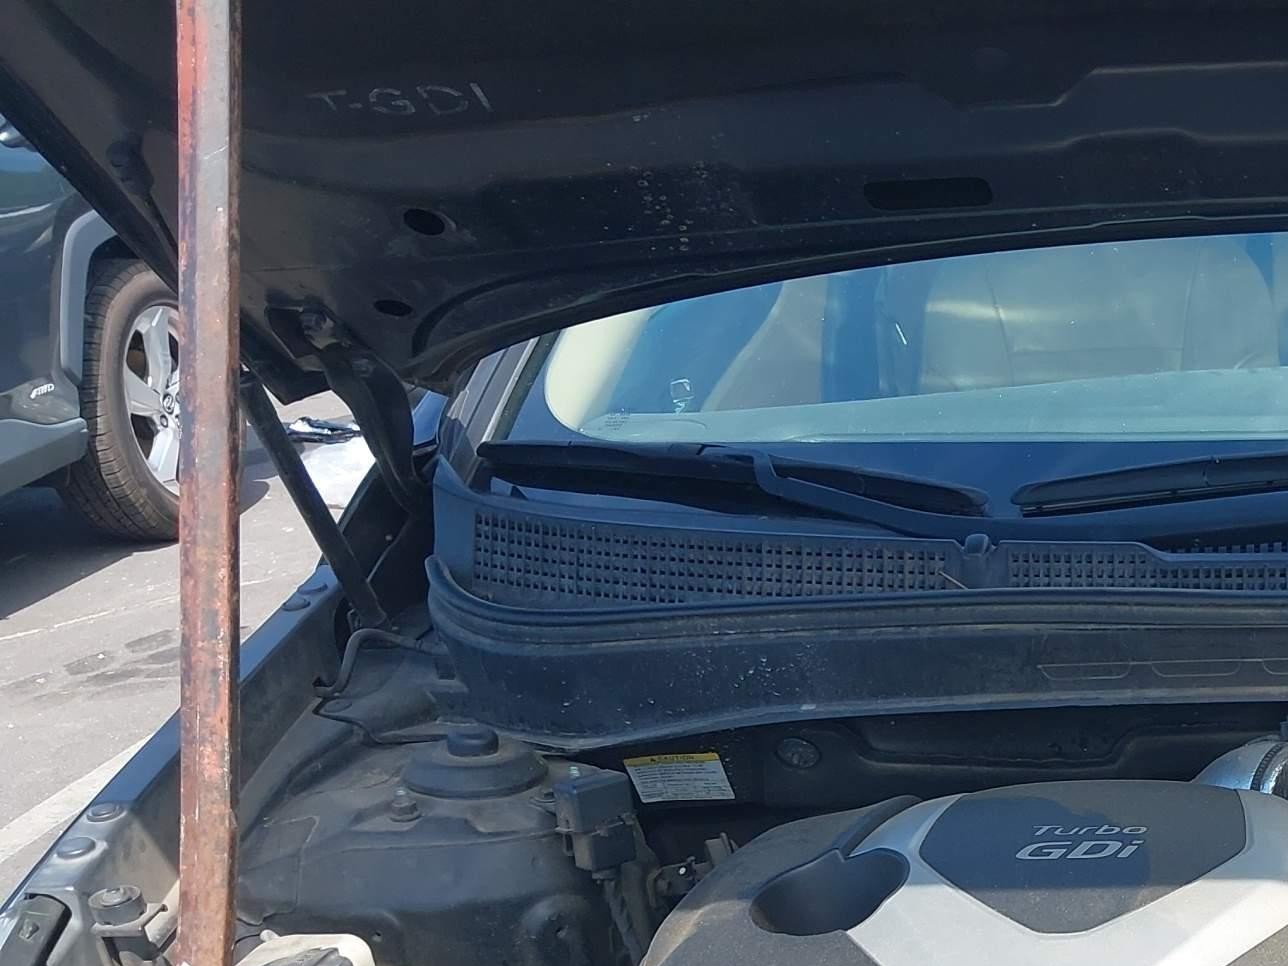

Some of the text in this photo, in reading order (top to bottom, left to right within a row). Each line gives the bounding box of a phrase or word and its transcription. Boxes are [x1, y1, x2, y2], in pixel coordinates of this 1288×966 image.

[304, 82, 494, 115] T-GDI
[1033, 824, 1148, 836] Turbo
[1015, 840, 1145, 860] GDi
